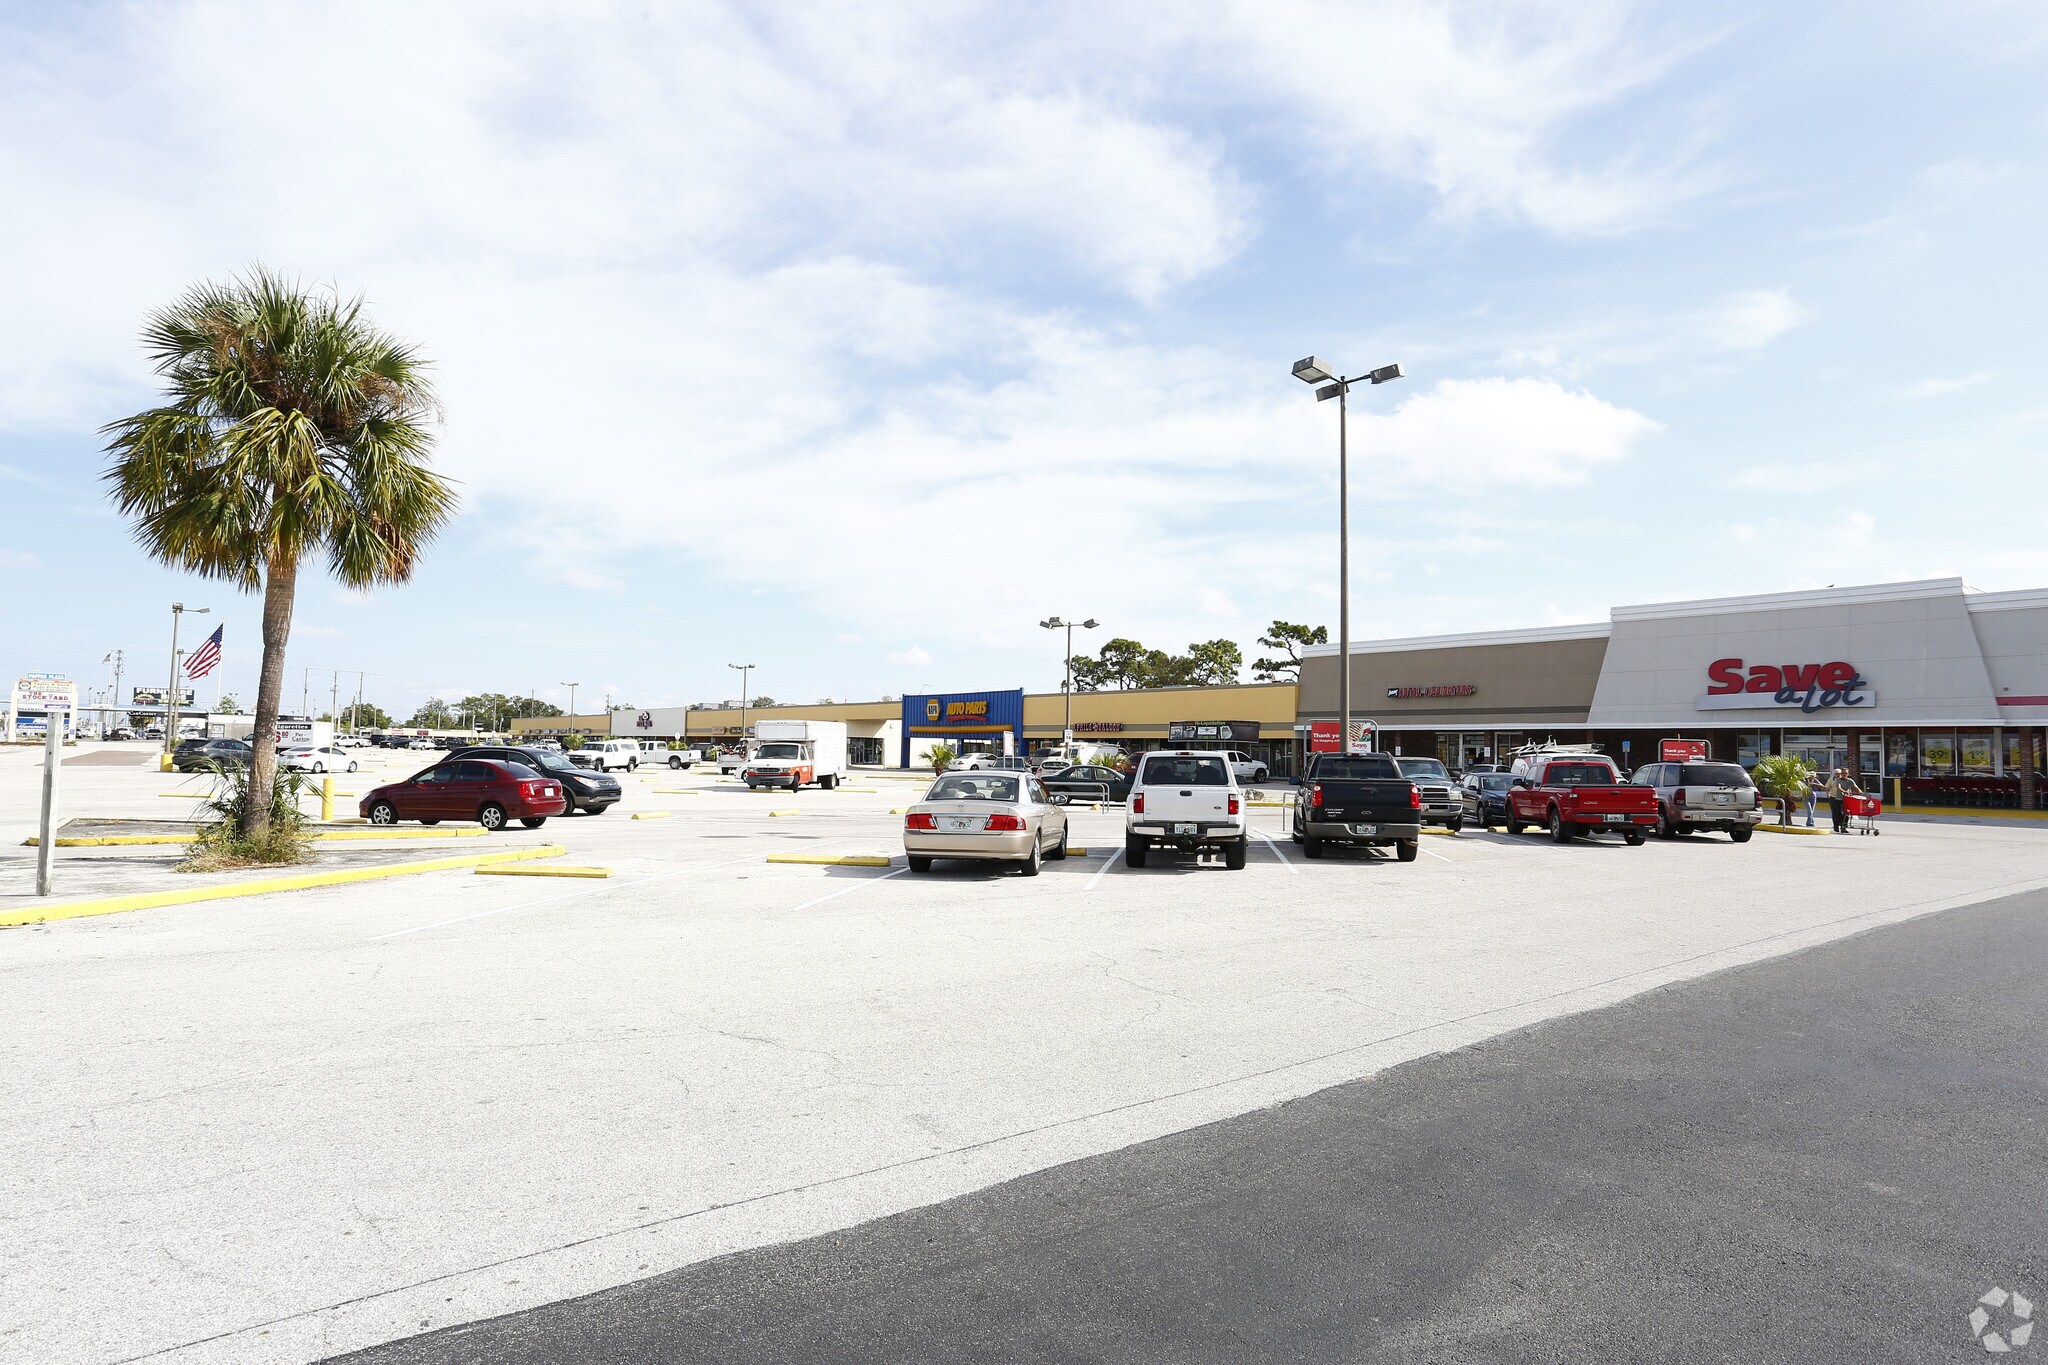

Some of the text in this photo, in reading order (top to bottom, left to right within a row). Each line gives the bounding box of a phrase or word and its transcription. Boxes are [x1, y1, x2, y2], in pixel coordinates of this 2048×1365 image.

[1707, 658, 1856, 695] Save
[1774, 686, 1803, 704] a
[928, 701, 987, 716] NAPA AUTO PARTS
